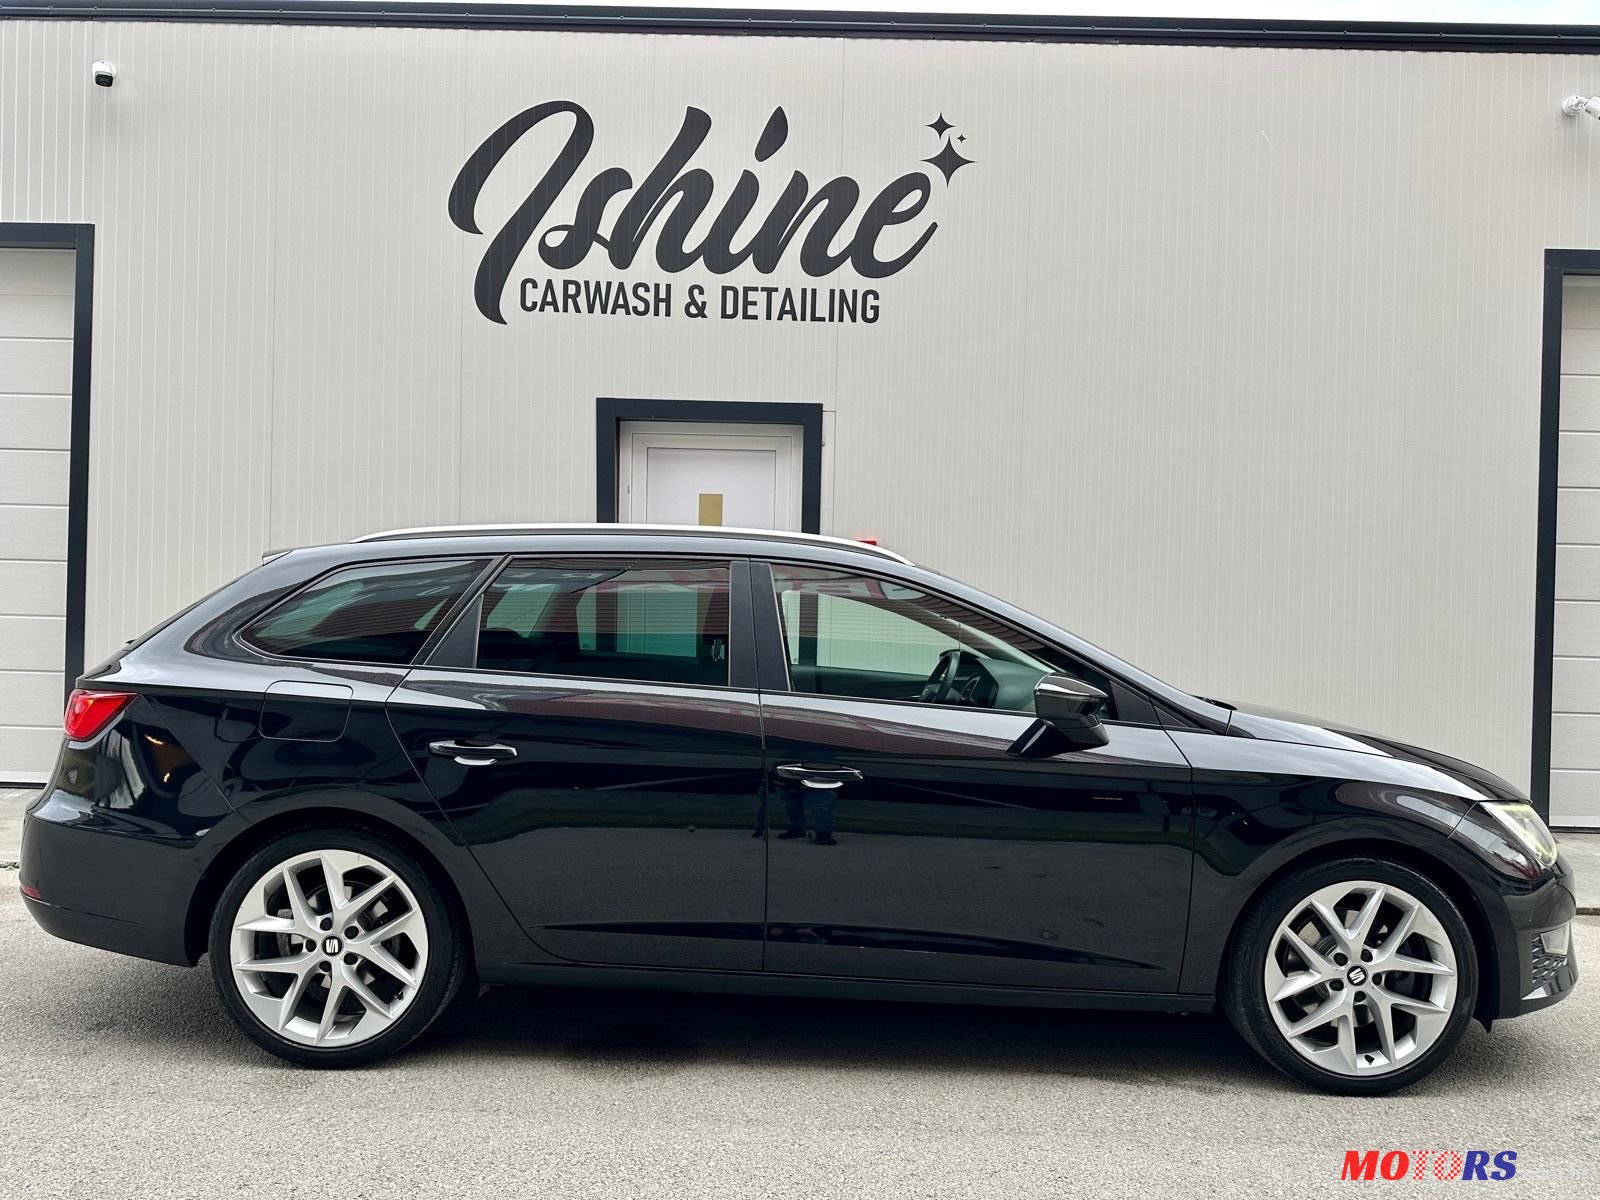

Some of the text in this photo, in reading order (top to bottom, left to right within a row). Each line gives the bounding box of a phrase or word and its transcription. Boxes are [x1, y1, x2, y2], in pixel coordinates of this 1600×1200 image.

[448, 100, 938, 326] Ishine
[520, 278, 880, 324] CARWASH & DETAILING
